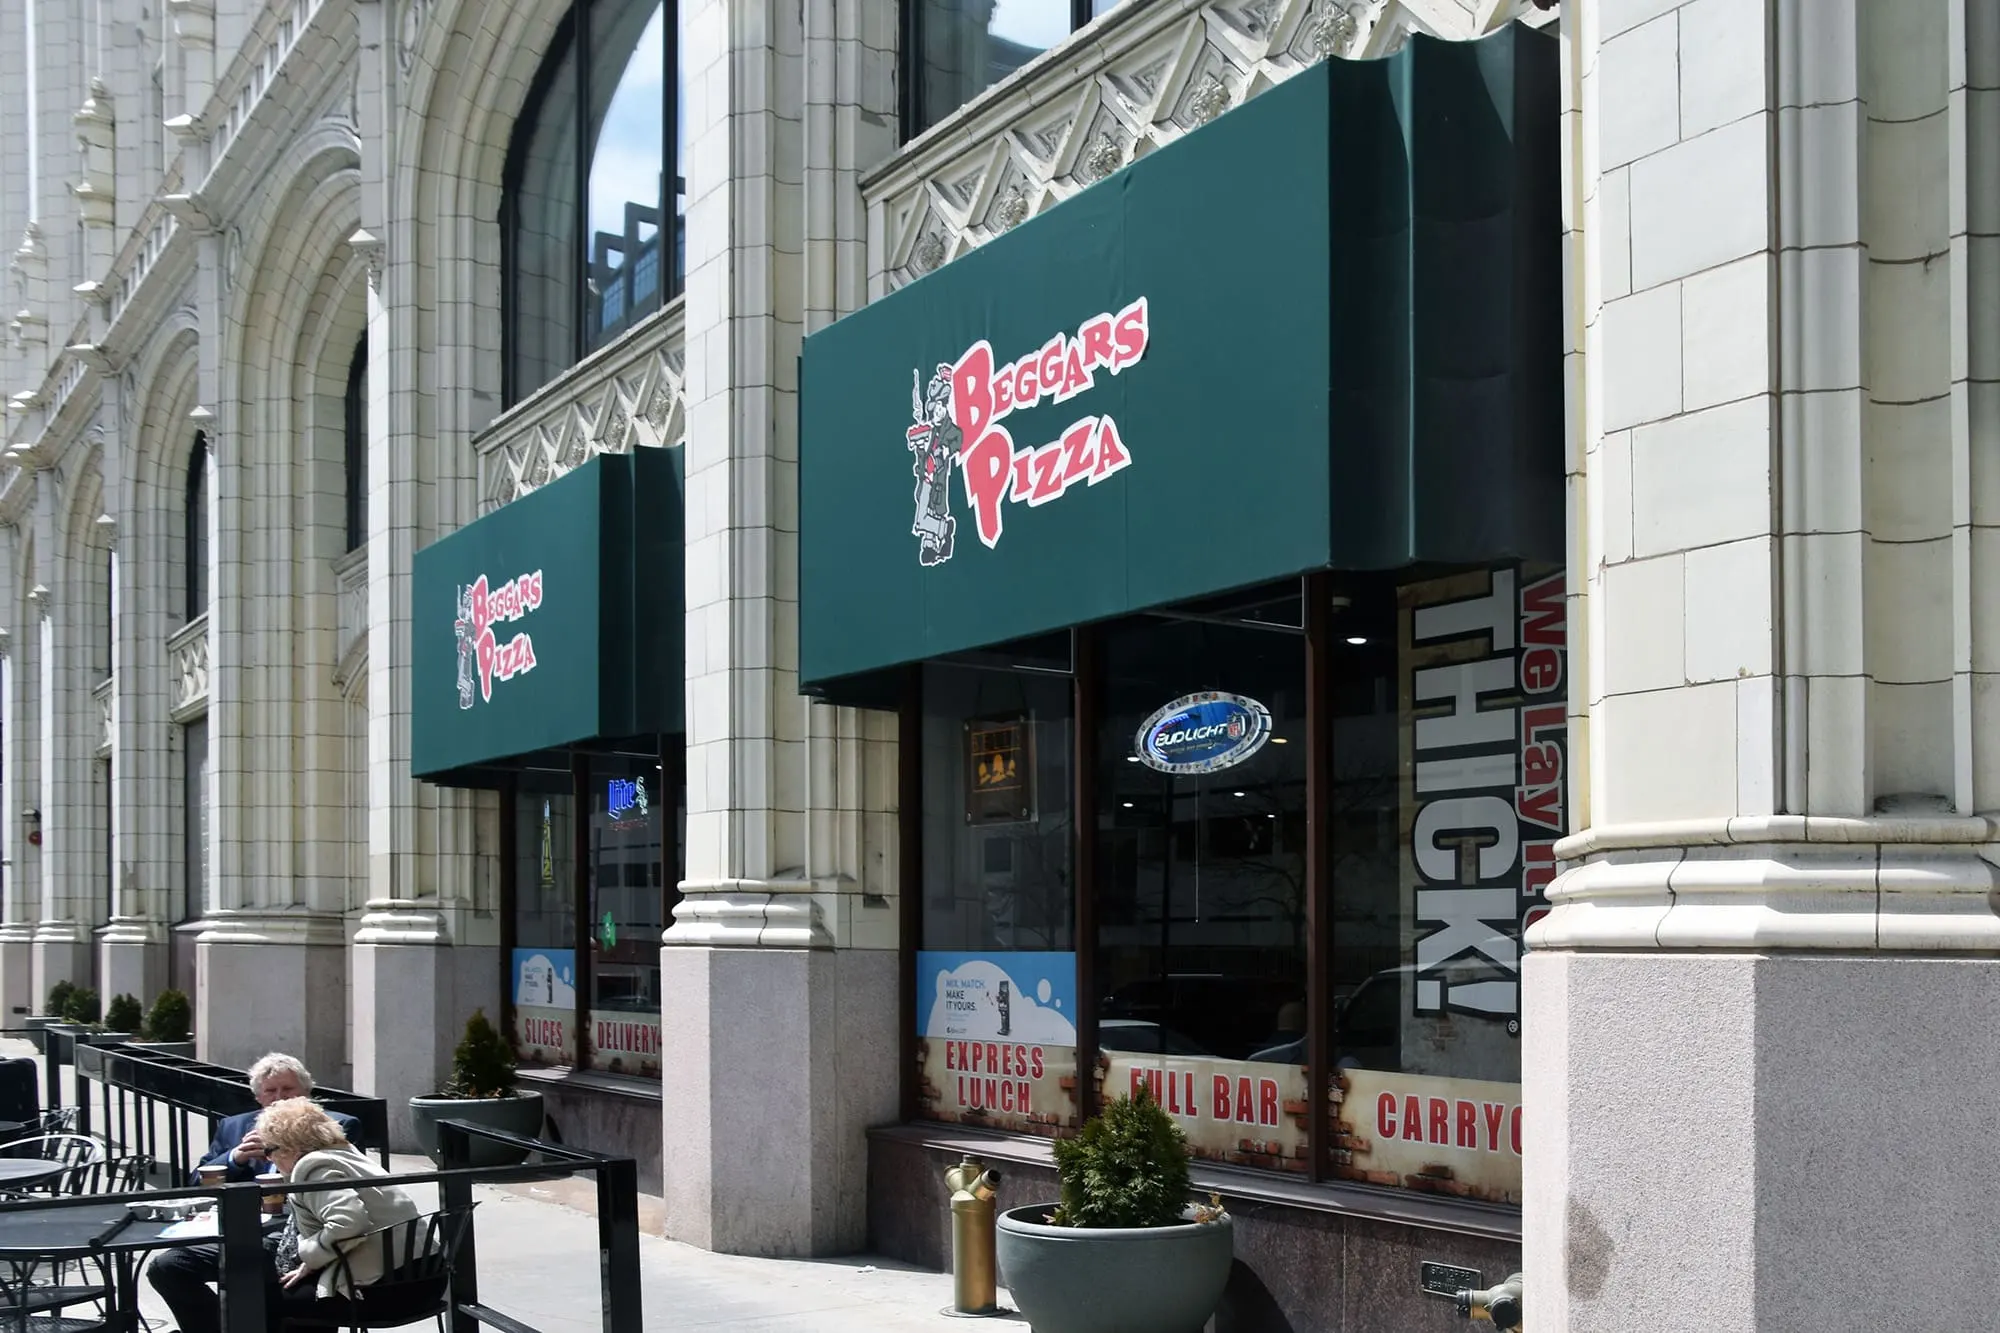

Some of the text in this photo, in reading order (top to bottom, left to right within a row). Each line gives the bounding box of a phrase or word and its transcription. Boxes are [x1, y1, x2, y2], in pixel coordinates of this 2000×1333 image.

[951, 297, 1148, 462] BEGGARS
[964, 416, 1131, 548] PIZZA
[472, 569, 542, 646] BEGGARS
[477, 628, 536, 702] PIZZA
[1415, 568, 1518, 1013] THICK!
[1515, 702, 1567, 832] Lay
[946, 990, 964, 999] MAKE
[946, 1001, 952, 1009] IT
[525, 1018, 563, 1049] SLICES
[597, 1021, 658, 1054] DELIVERY
[945, 1040, 1044, 1079] EXPRESS
[957, 1075, 1031, 1115] LUNCH
[1213, 1073, 1280, 1127] BAR
